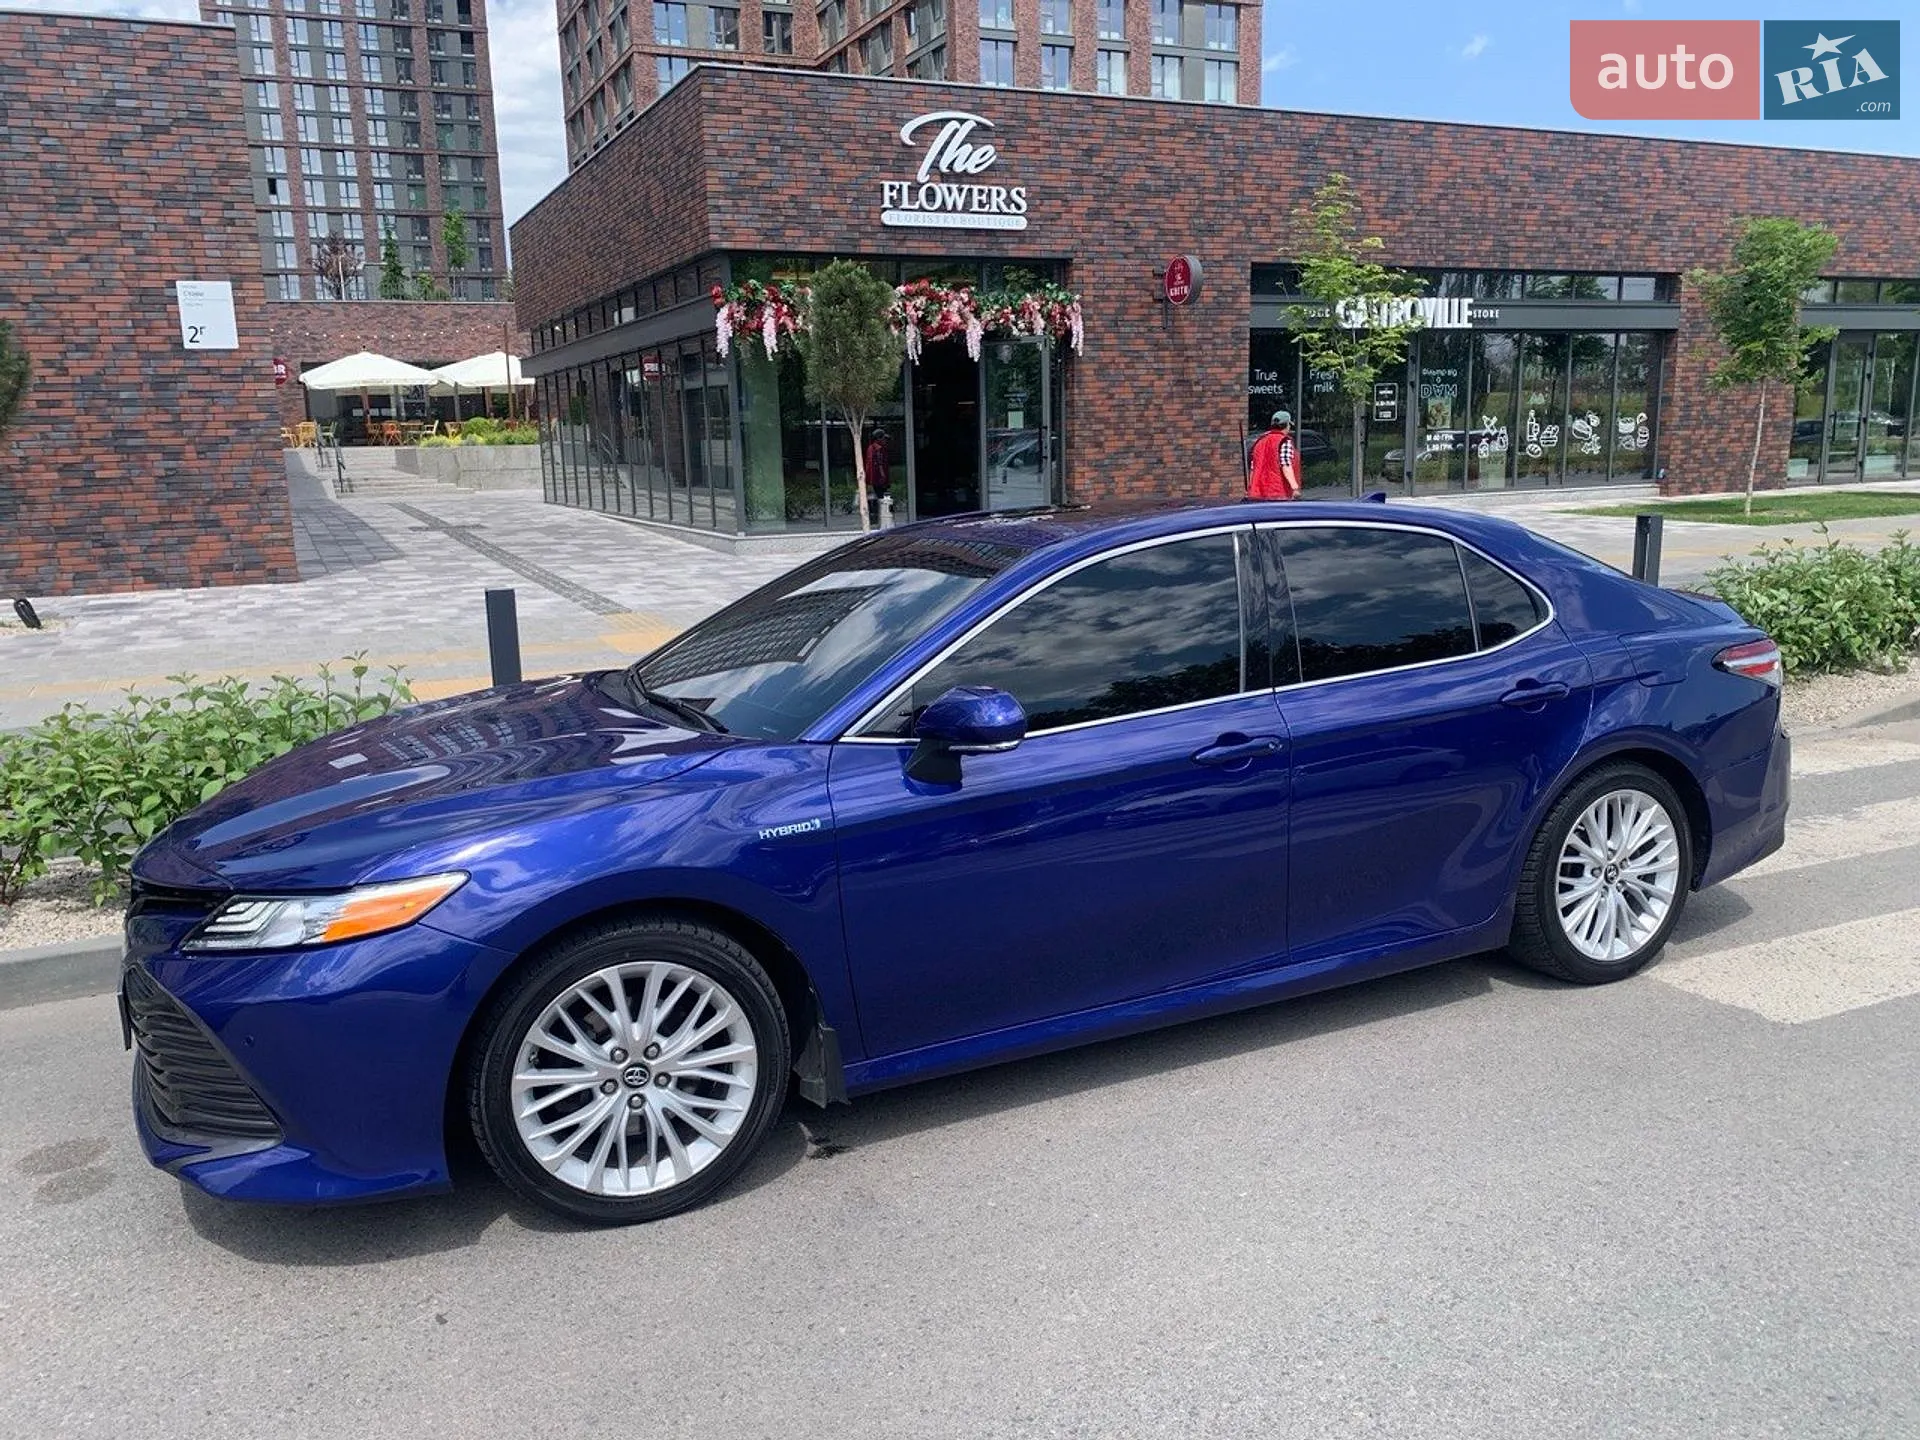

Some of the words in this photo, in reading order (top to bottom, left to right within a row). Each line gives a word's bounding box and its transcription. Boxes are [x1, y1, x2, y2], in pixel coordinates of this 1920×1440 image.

[900, 111, 997, 184] The
[880, 180, 1028, 214] FLOWERS
[1473, 308, 1500, 319] STORE
[1254, 369, 1278, 381] True
[1309, 368, 1339, 381] Fresh
[1247, 383, 1284, 394] sweets
[1313, 382, 1335, 393] milk
[759, 822, 811, 840] HYBRID
